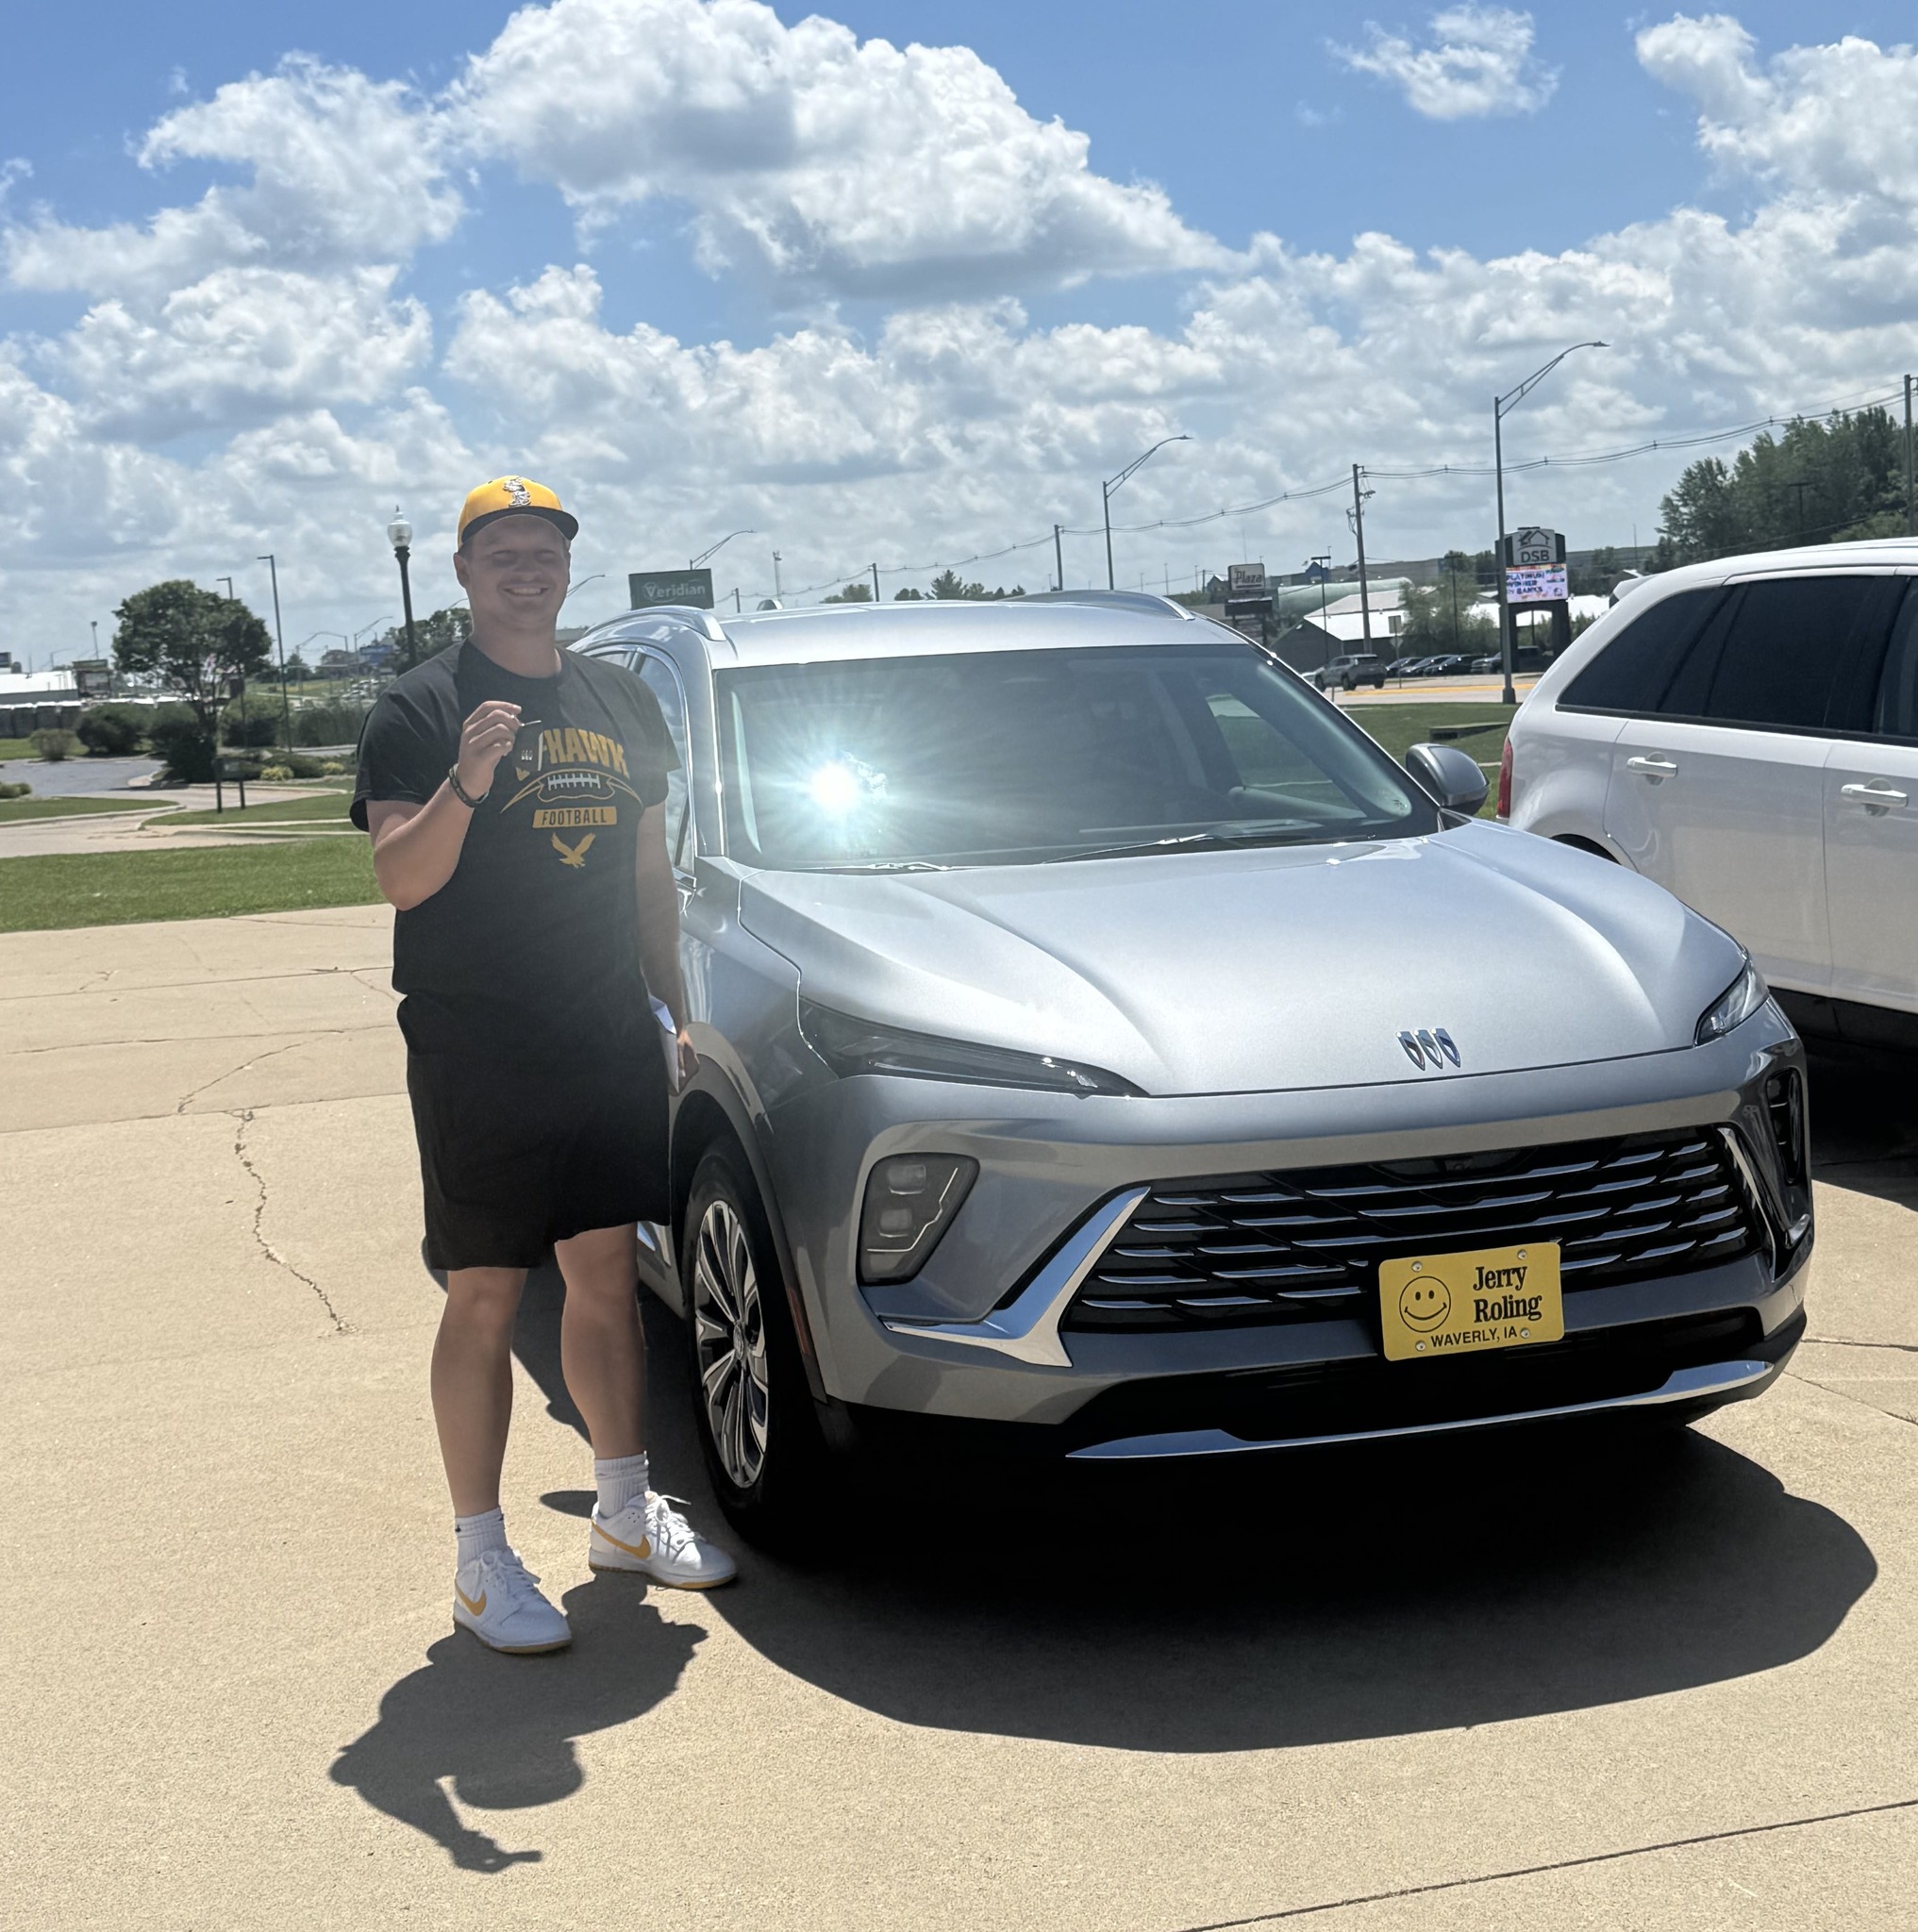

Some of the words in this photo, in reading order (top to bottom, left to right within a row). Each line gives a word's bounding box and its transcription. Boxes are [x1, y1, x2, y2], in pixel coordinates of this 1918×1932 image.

[1521, 549, 1550, 563] DSB
[1233, 570, 1262, 584] Plaza
[643, 582, 706, 598] Veridian
[542, 809, 607, 825] FOOTBALL
[1473, 1266, 1527, 1291] Jerry
[1474, 1294, 1543, 1323] Roling
[1430, 1327, 1500, 1348] WAVERLY,
[1504, 1325, 1518, 1339] IA
